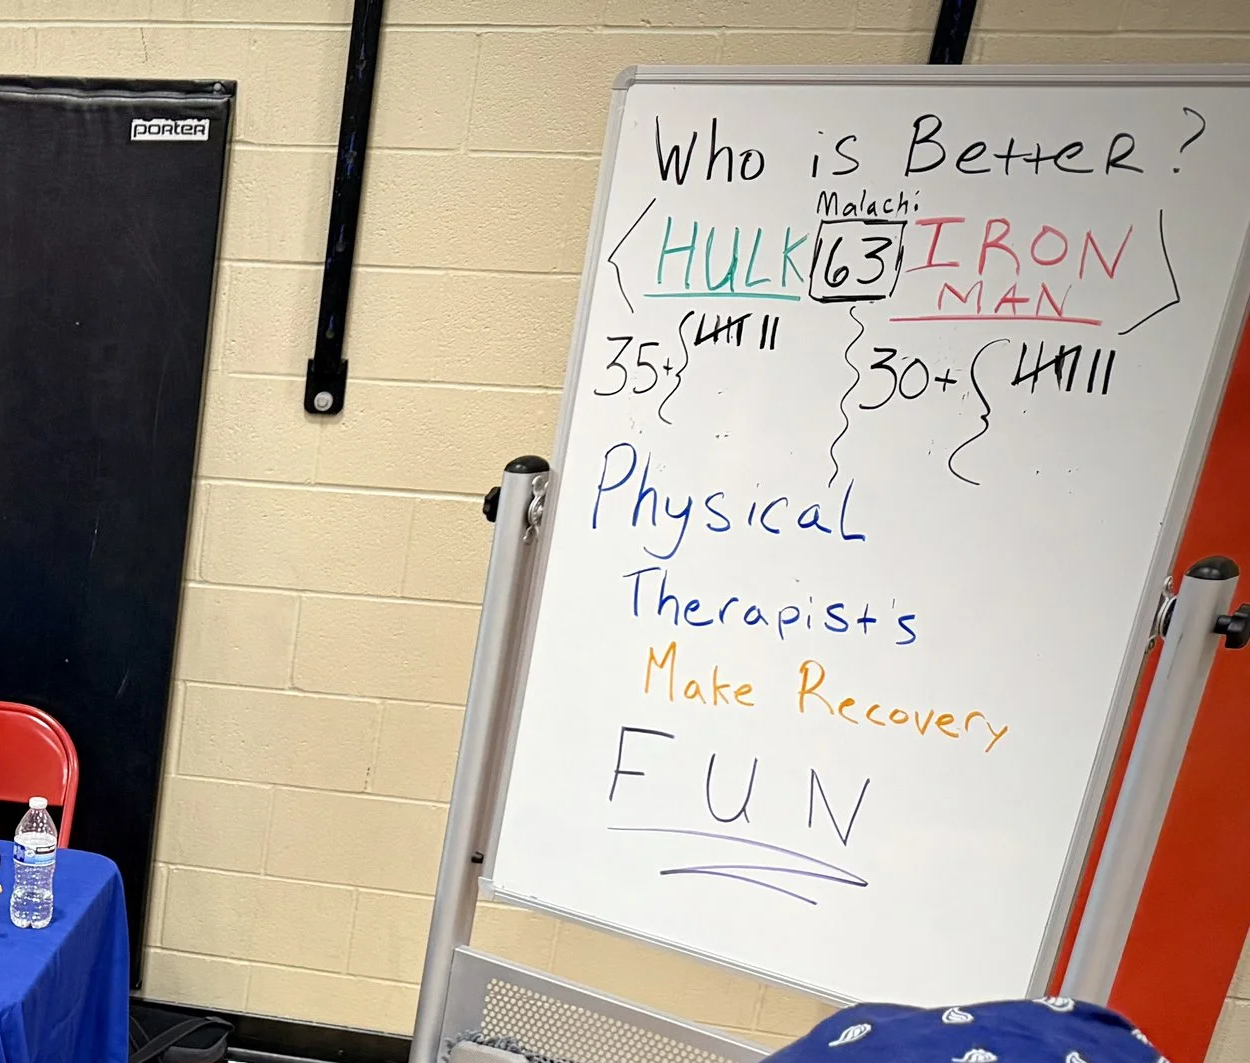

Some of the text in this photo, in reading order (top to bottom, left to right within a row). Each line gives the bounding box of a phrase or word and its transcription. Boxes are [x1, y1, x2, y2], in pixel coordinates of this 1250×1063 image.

[655, 115, 766, 186] Who
[812, 130, 860, 178] is
[816, 190, 921, 219] Malachi
[656, 215, 808, 292] HULK
[820, 235, 893, 288] 63
[905, 216, 1133, 280] IRON
[938, 281, 1071, 319] MAN
[643, 641, 1009, 753] Make Recovery
